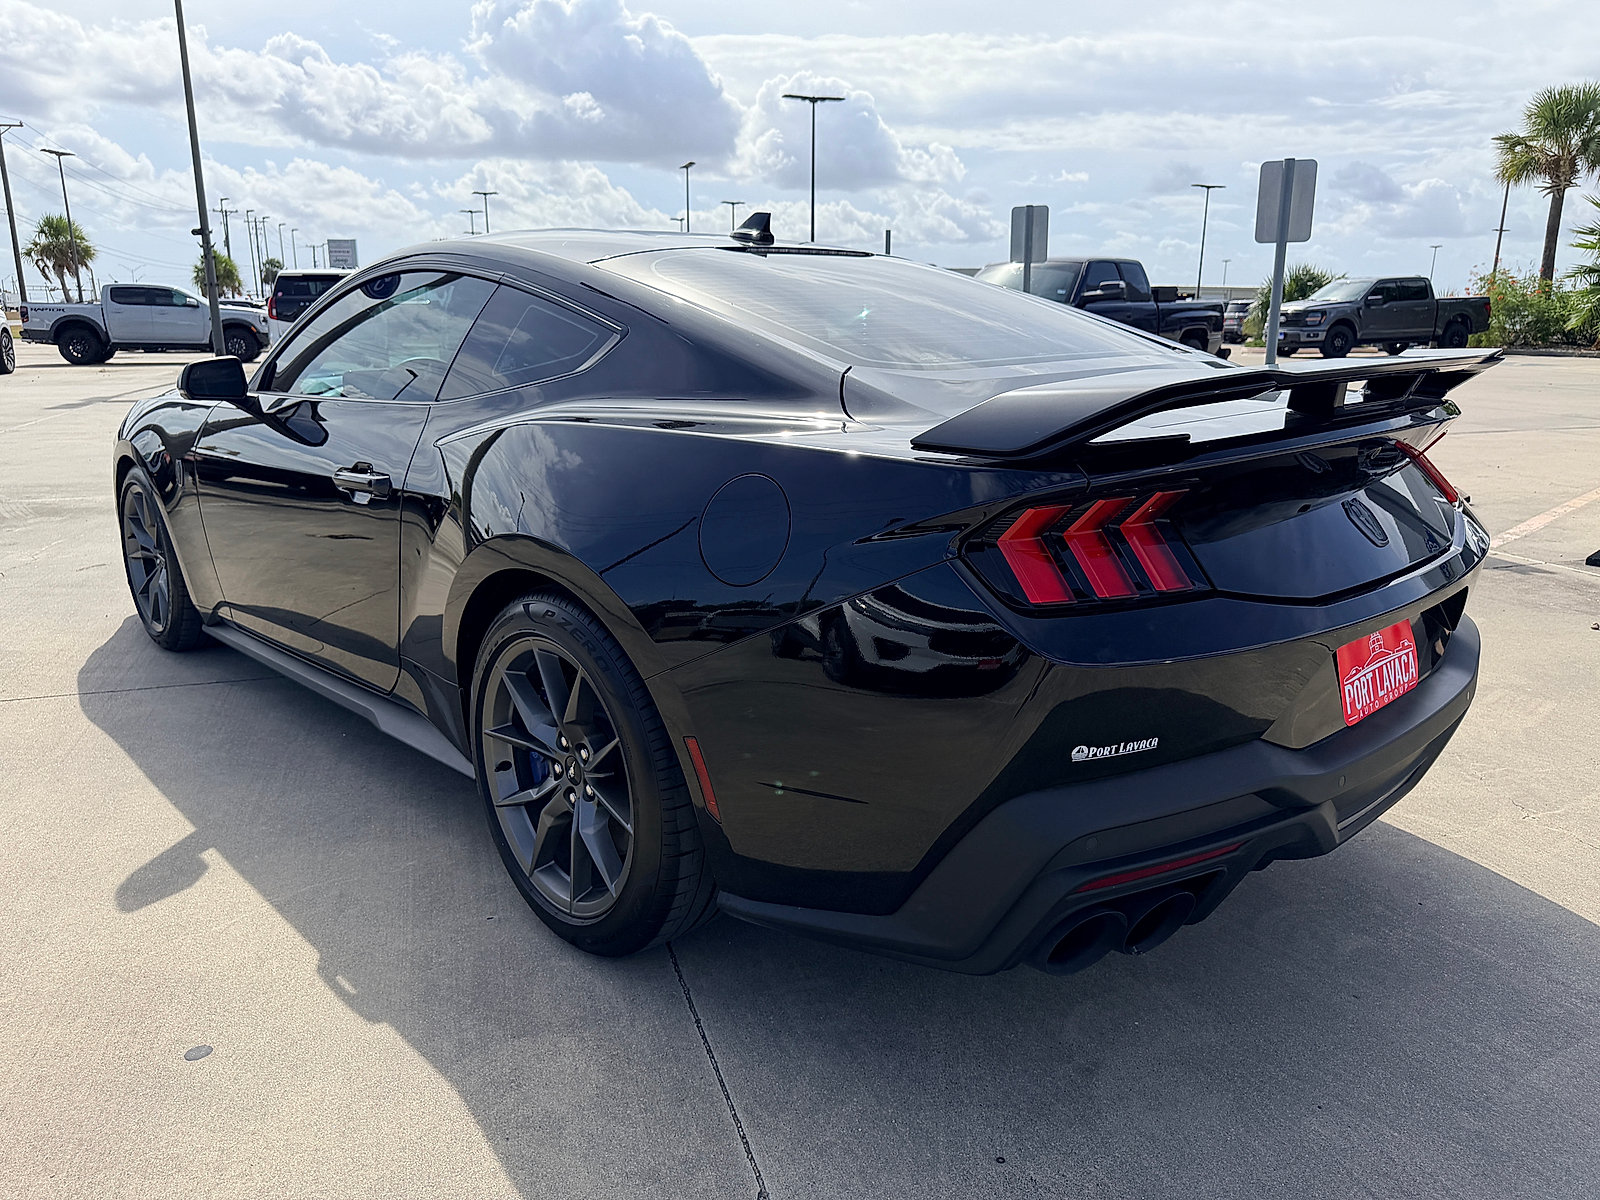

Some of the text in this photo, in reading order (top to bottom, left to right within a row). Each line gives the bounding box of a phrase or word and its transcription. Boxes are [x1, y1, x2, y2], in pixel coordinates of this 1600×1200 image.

[543, 609, 610, 672] P ZERO
[1344, 652, 1416, 715] PORT LAVACA
[1360, 684, 1408, 718] AUTO GROUP
